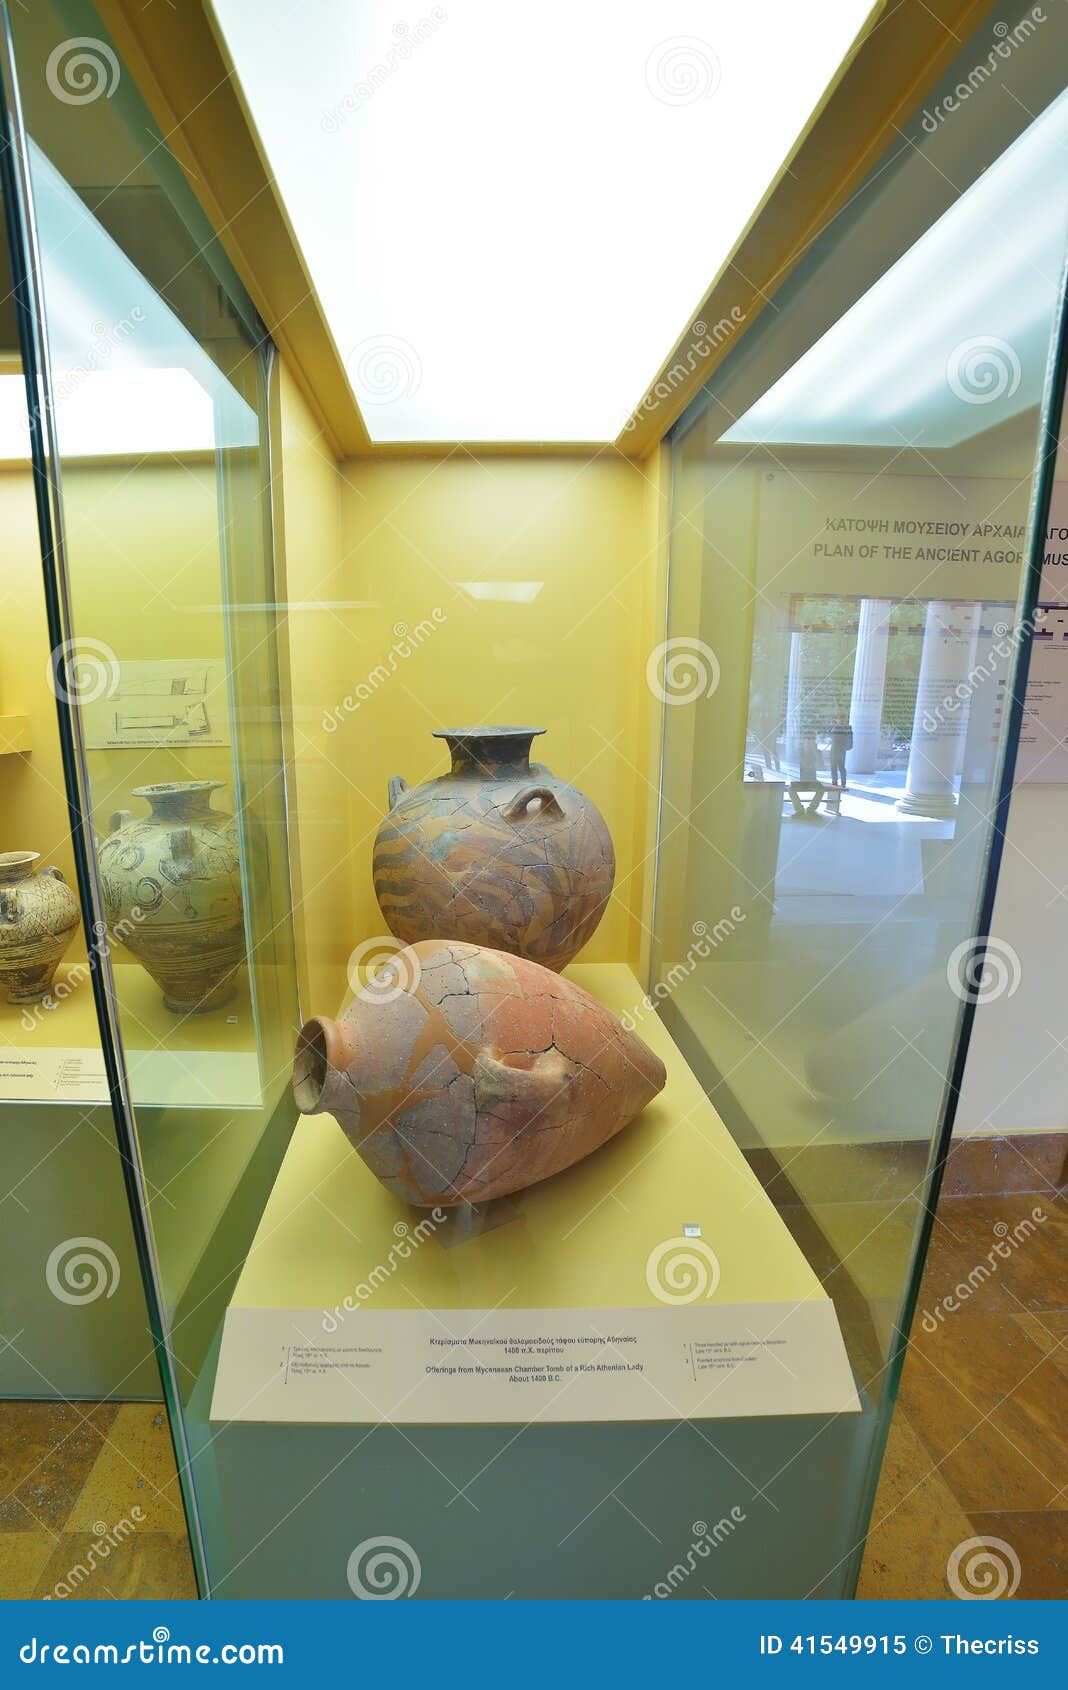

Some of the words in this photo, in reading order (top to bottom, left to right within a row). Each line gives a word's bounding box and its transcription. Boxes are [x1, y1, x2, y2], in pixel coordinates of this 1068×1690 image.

[825, 518, 889, 533] ΚΑΤΟΨΗ
[893, 520, 970, 536] ΜΟΥΣΕΙΟΥ
[972, 523, 1026, 538] ΑΡΧΑΙΑ
[813, 543, 854, 557] PLAN
[858, 545, 879, 559] OF
[882, 545, 912, 560] THE
[915, 547, 980, 562] ANCIENT
[982, 550, 1025, 564] AGOR
[514, 1365, 544, 1373] Chamber
[546, 1364, 565, 1372] Tomb
[508, 1375, 530, 1383] About
